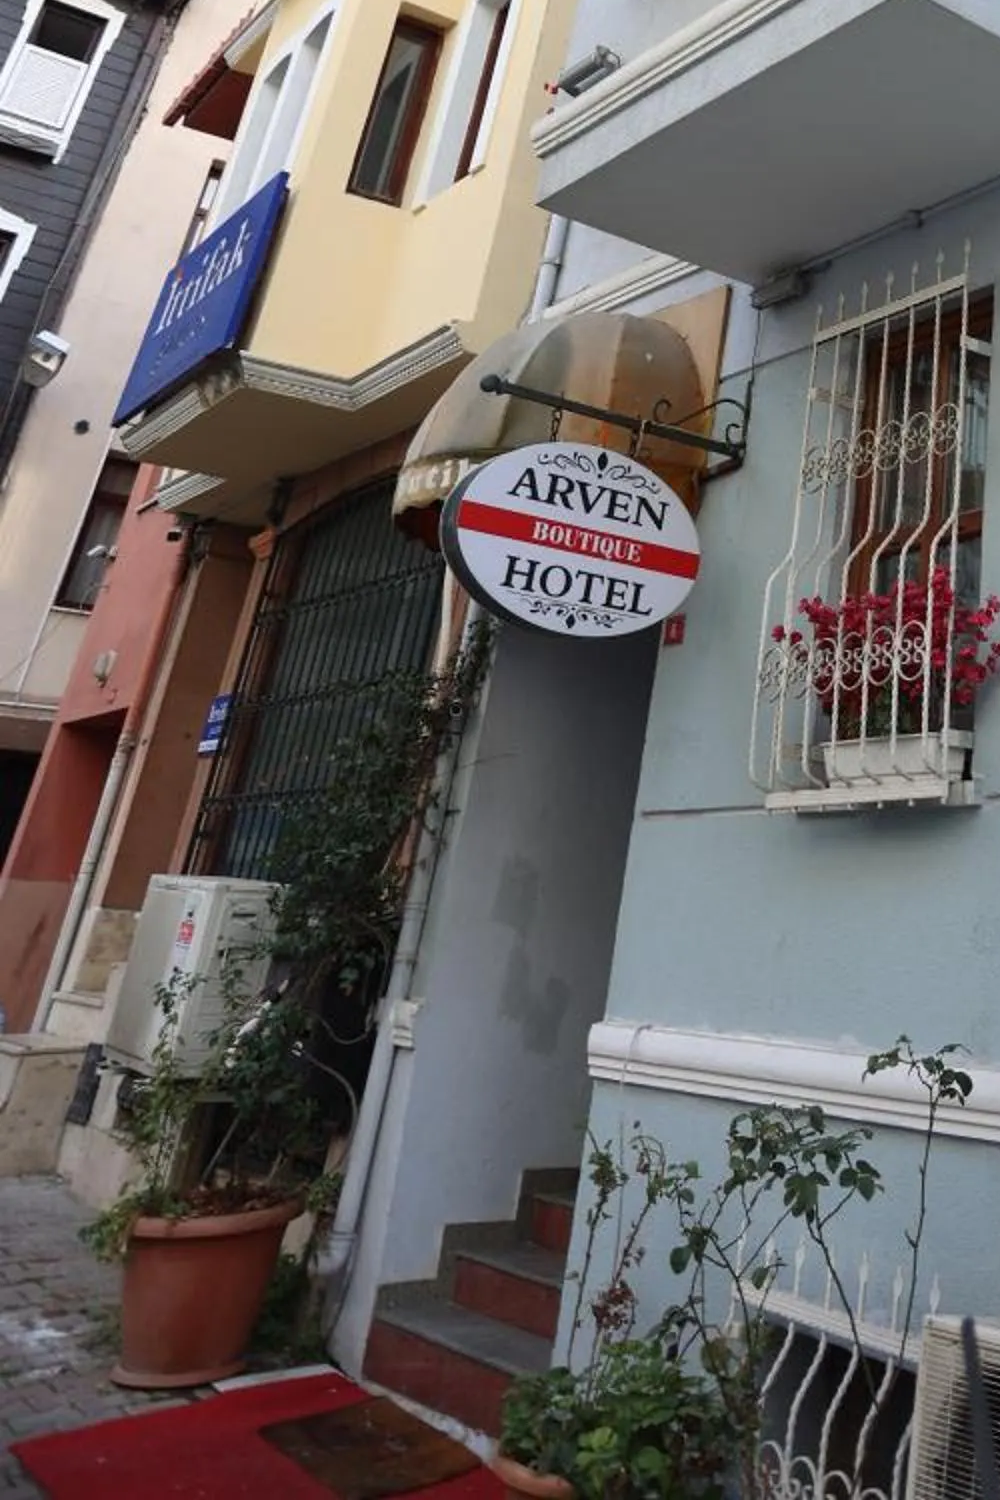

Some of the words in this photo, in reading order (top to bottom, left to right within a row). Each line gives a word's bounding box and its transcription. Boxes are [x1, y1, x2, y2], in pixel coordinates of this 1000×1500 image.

[508, 467, 670, 531] ARVEN
[532, 521, 641, 563] BOUTIQUE
[500, 555, 653, 617] HOTEL
